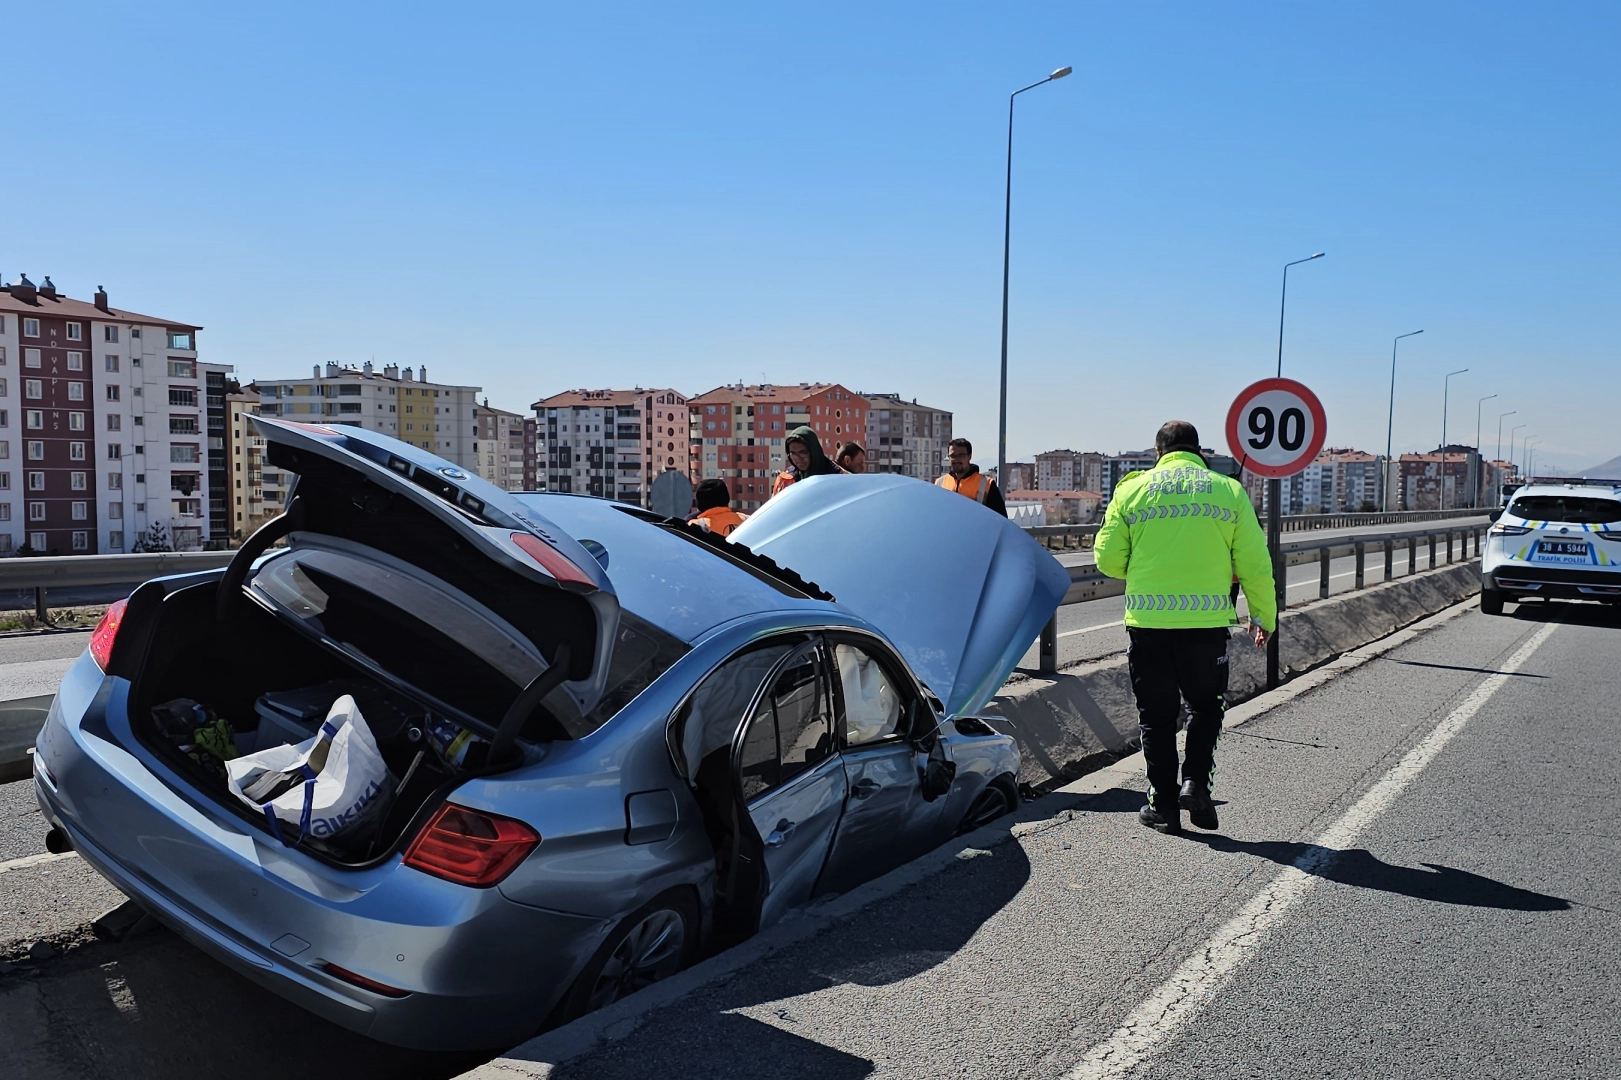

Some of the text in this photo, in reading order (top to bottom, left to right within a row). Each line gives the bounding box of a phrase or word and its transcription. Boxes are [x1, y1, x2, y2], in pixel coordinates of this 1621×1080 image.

[1248, 406, 1305, 451] 90
[1542, 543, 1586, 553] 38 A 5944
